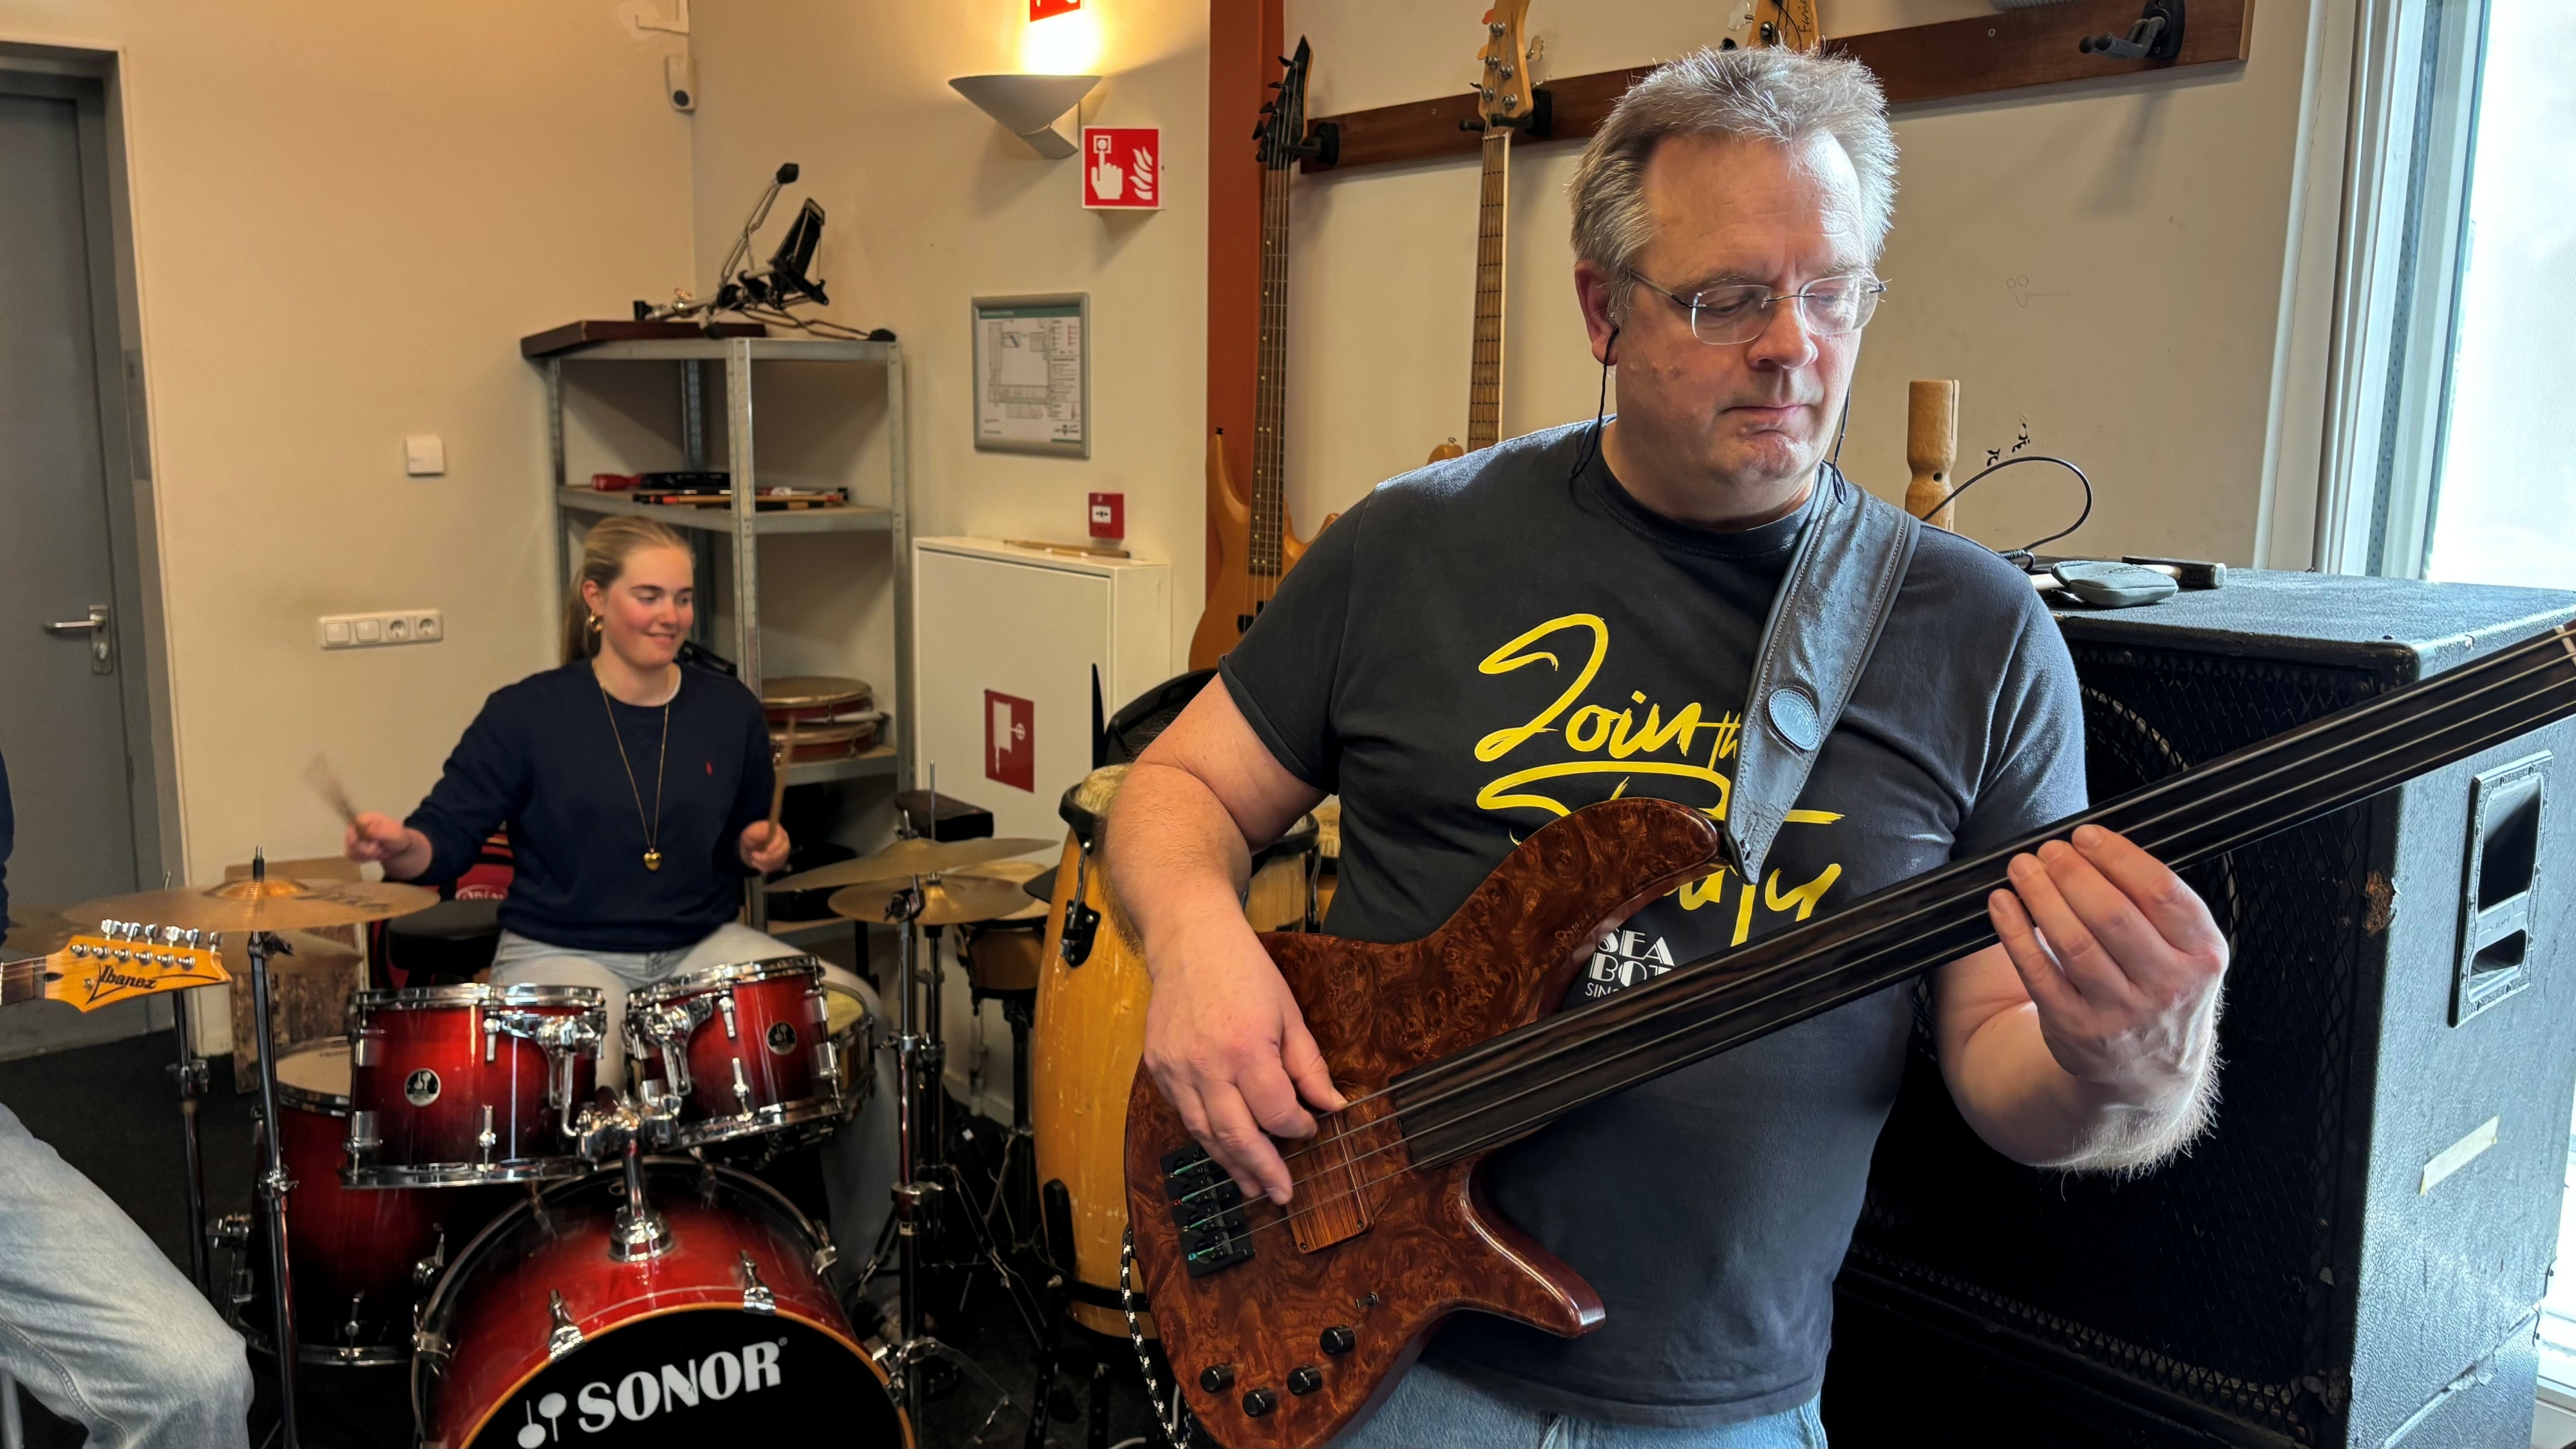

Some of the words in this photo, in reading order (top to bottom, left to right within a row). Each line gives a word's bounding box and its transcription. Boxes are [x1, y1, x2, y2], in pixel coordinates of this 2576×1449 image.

[1474, 613, 1702, 762] Join
[1706, 710, 1742, 771] th
[100, 965, 157, 989] Ibanez
[1585, 982, 1620, 998] SIN
[577, 1341, 781, 1434] SONOR
